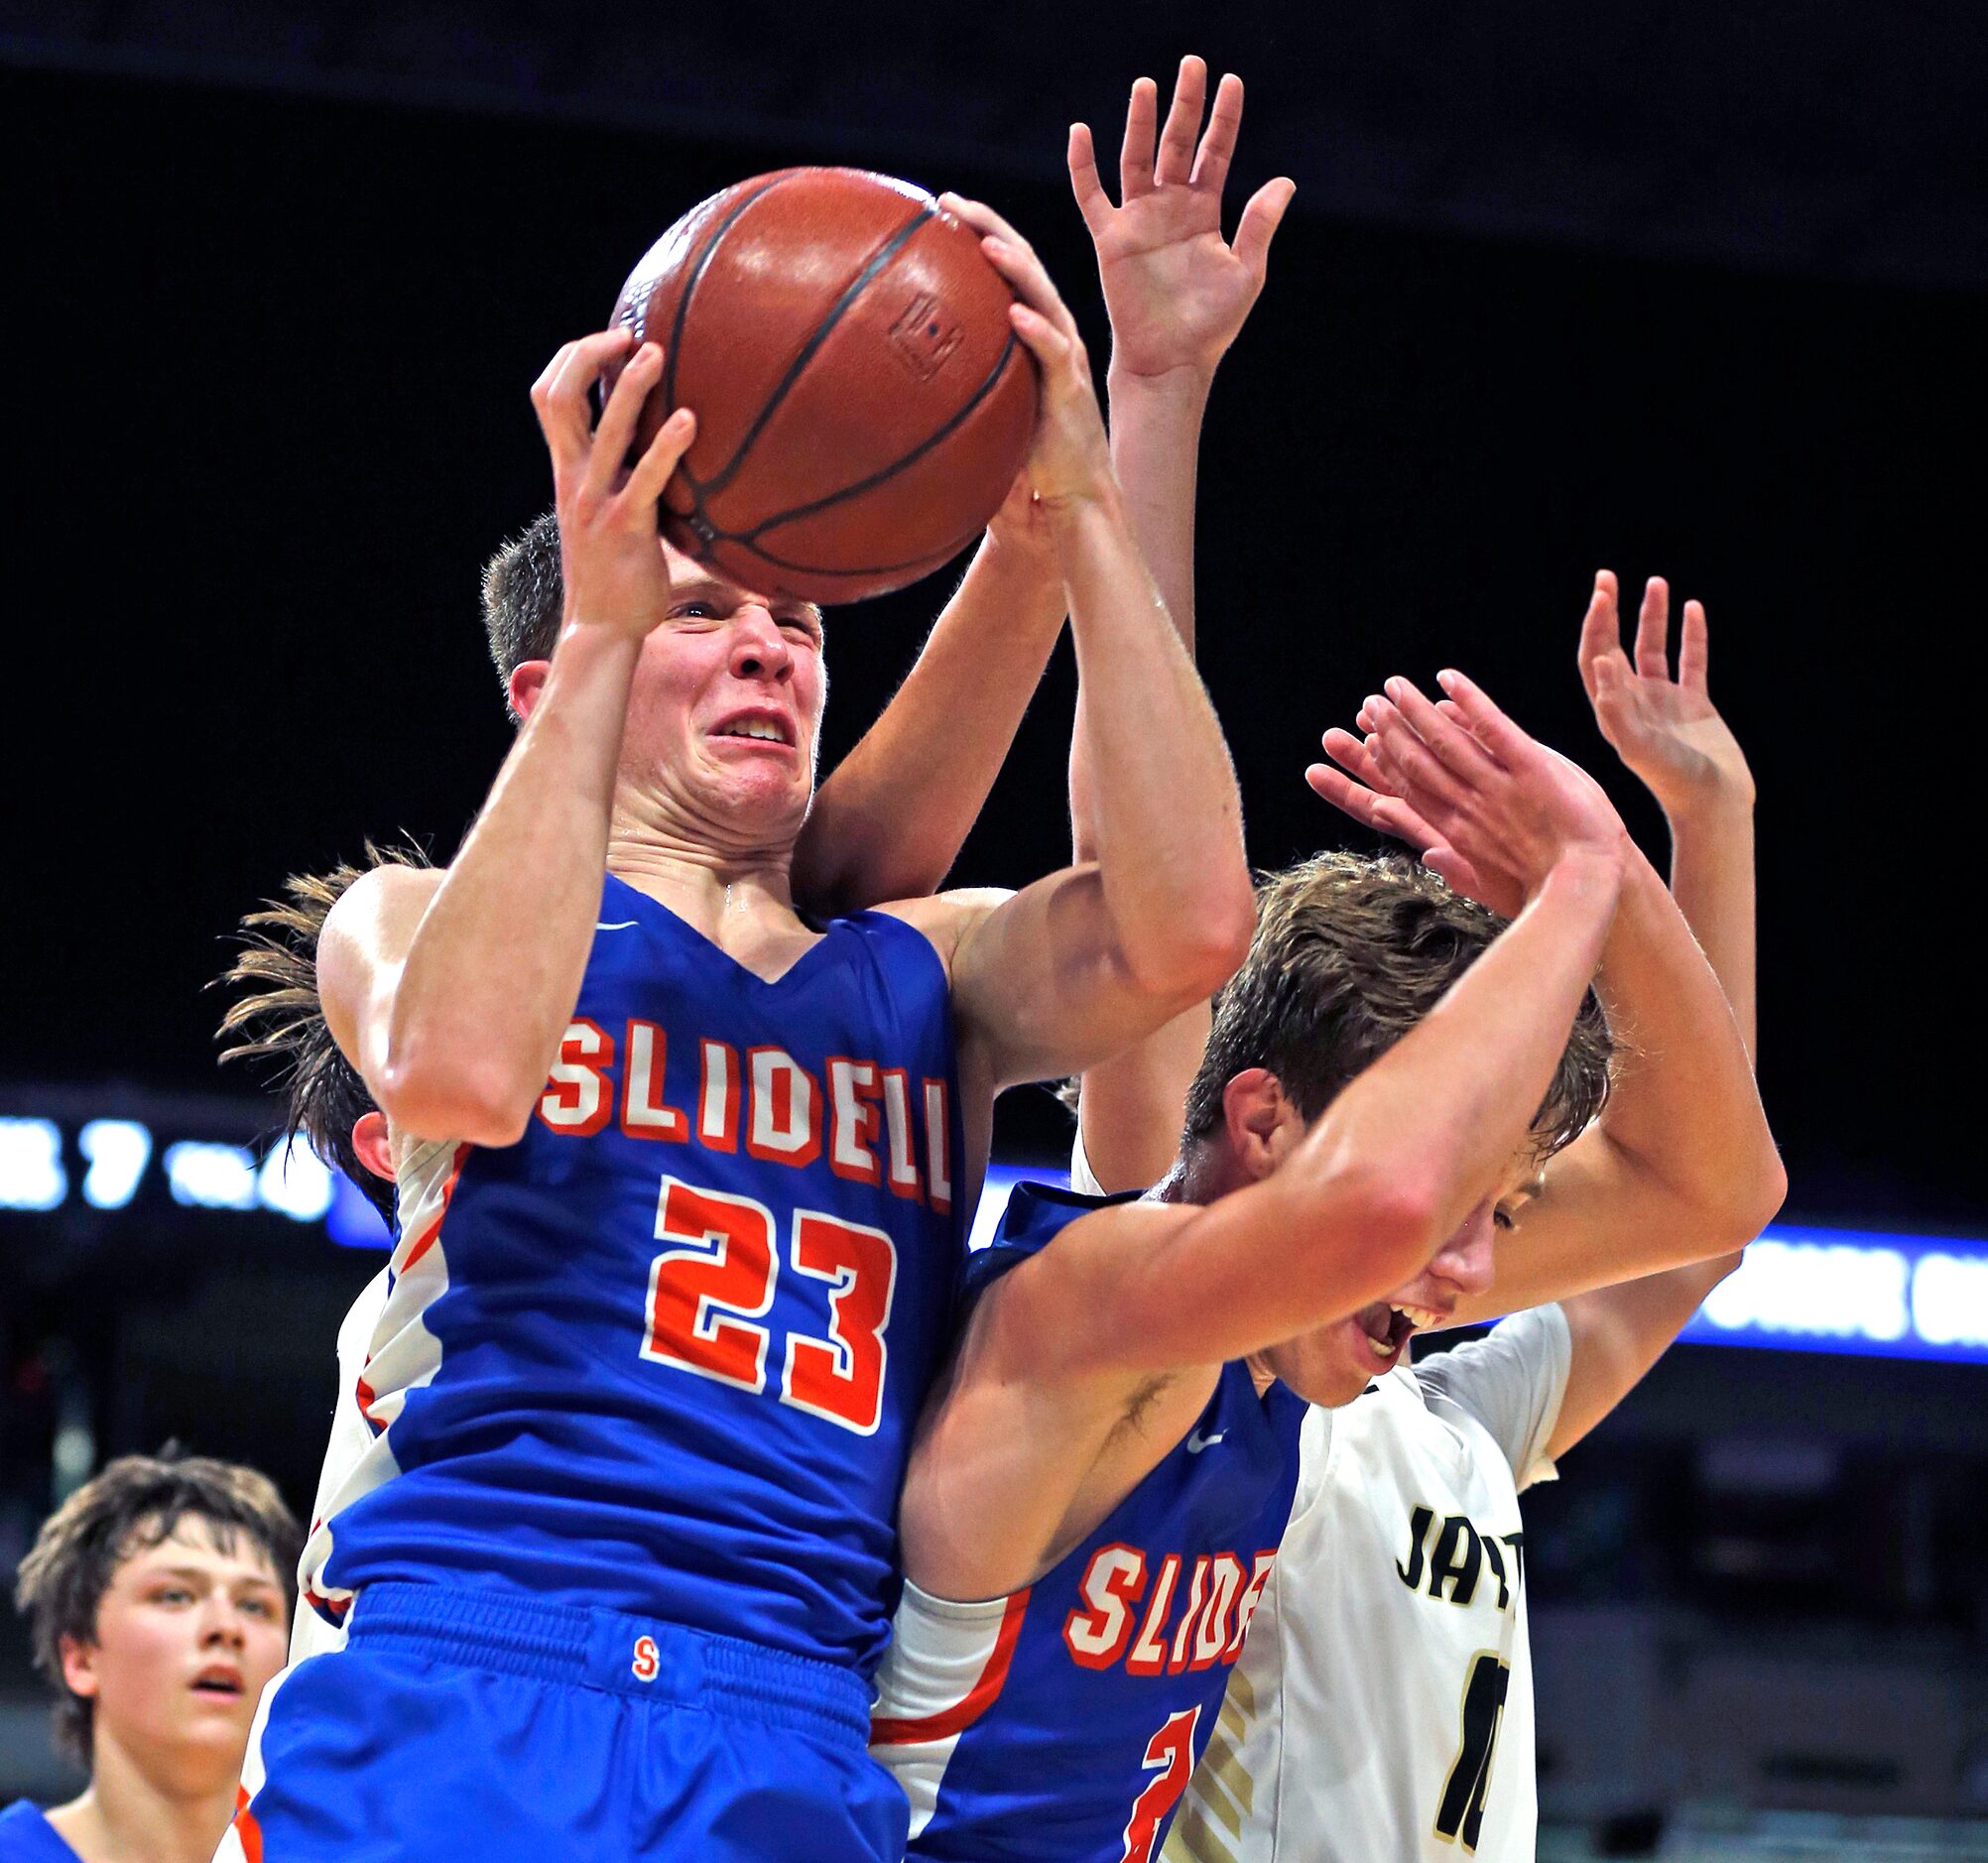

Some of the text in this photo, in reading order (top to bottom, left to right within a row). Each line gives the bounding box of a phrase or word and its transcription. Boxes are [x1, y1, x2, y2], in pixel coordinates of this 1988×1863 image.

[535, 1016, 951, 1216] SLIDELL
[639, 1174, 898, 1436] 23
[631, 1635, 660, 1682] S
